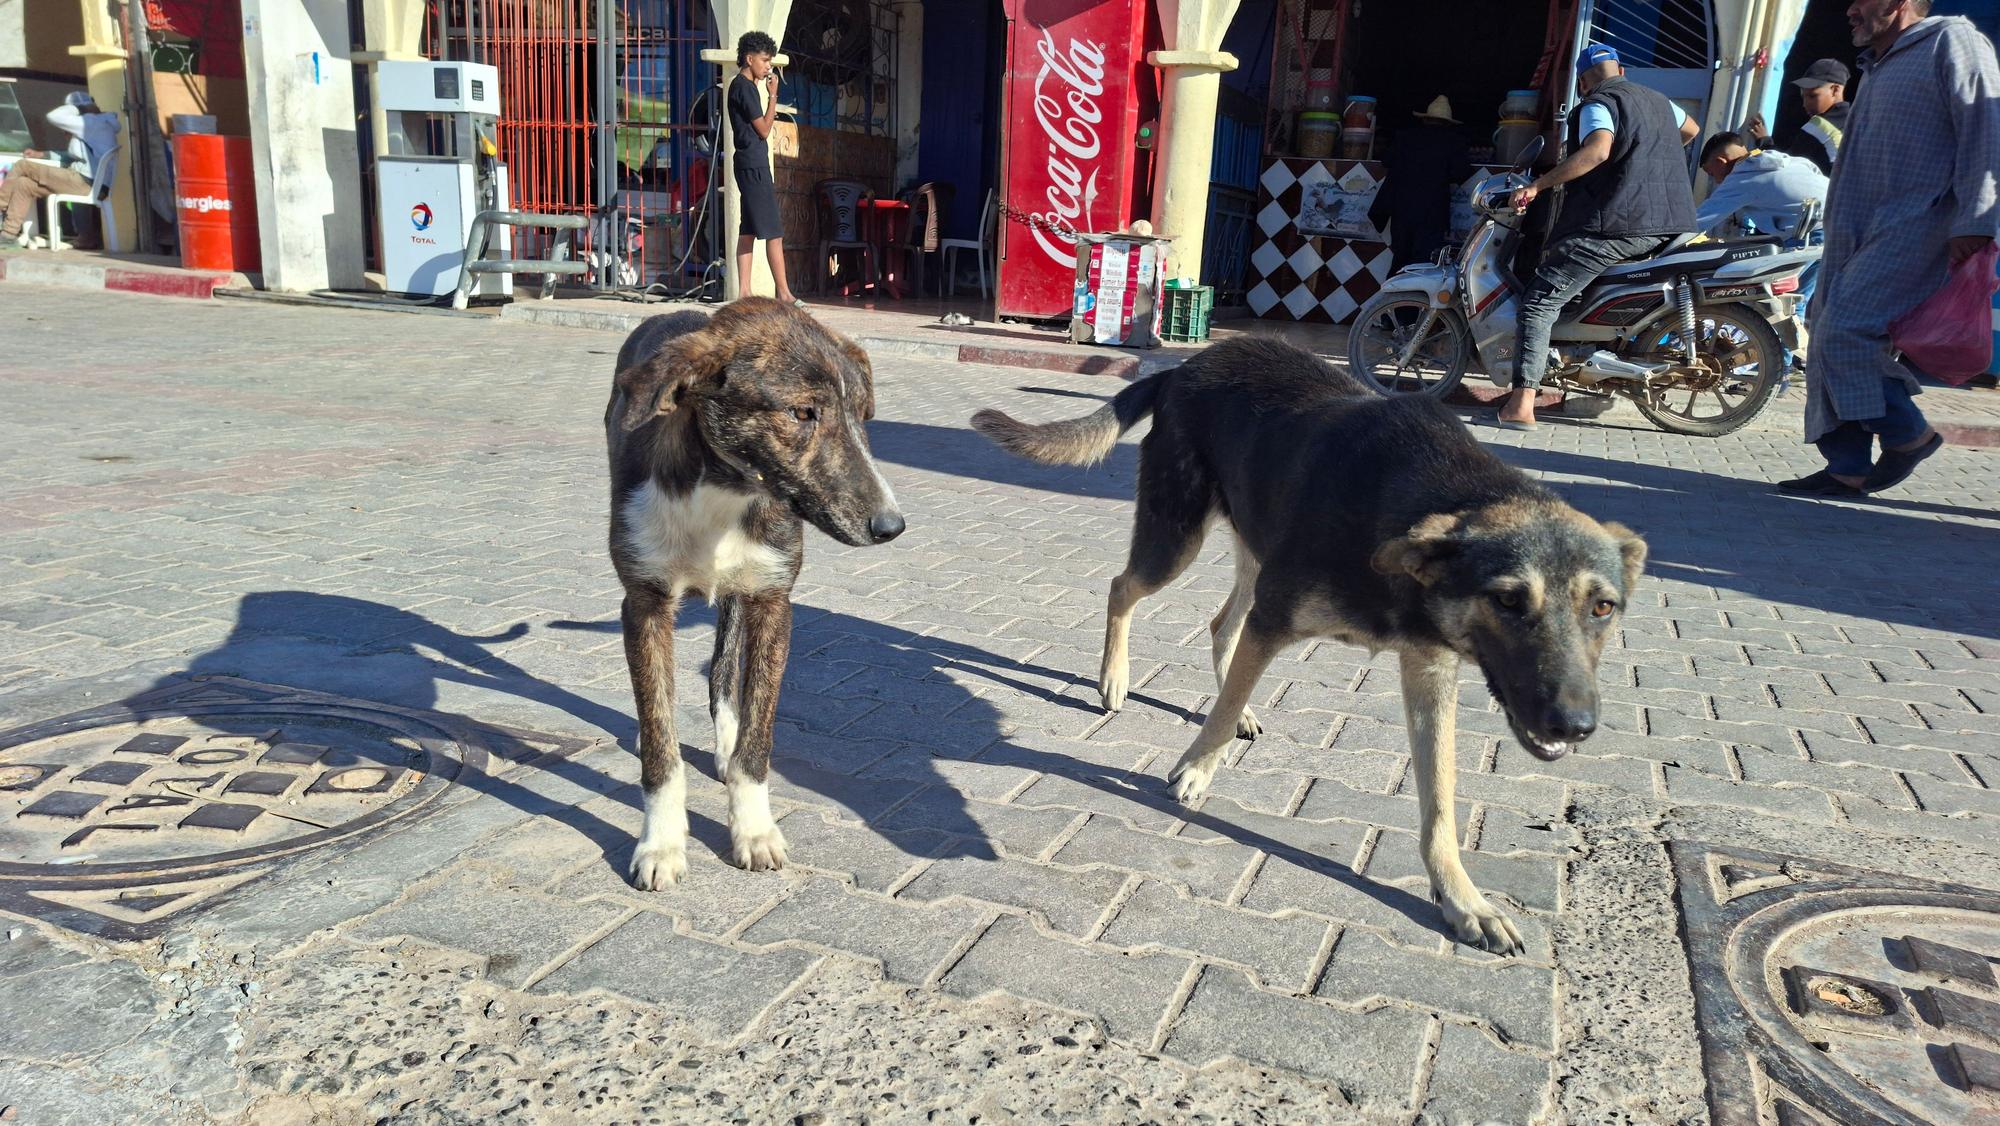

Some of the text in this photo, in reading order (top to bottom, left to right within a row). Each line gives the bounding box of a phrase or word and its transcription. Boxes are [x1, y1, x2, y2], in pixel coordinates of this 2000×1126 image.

[1031, 24, 1105, 269] Coca-Cola
[411, 235, 437, 245] TOTAL
[1732, 249, 1760, 259] FIFTY
[1627, 271, 1651, 279] DOCKER
